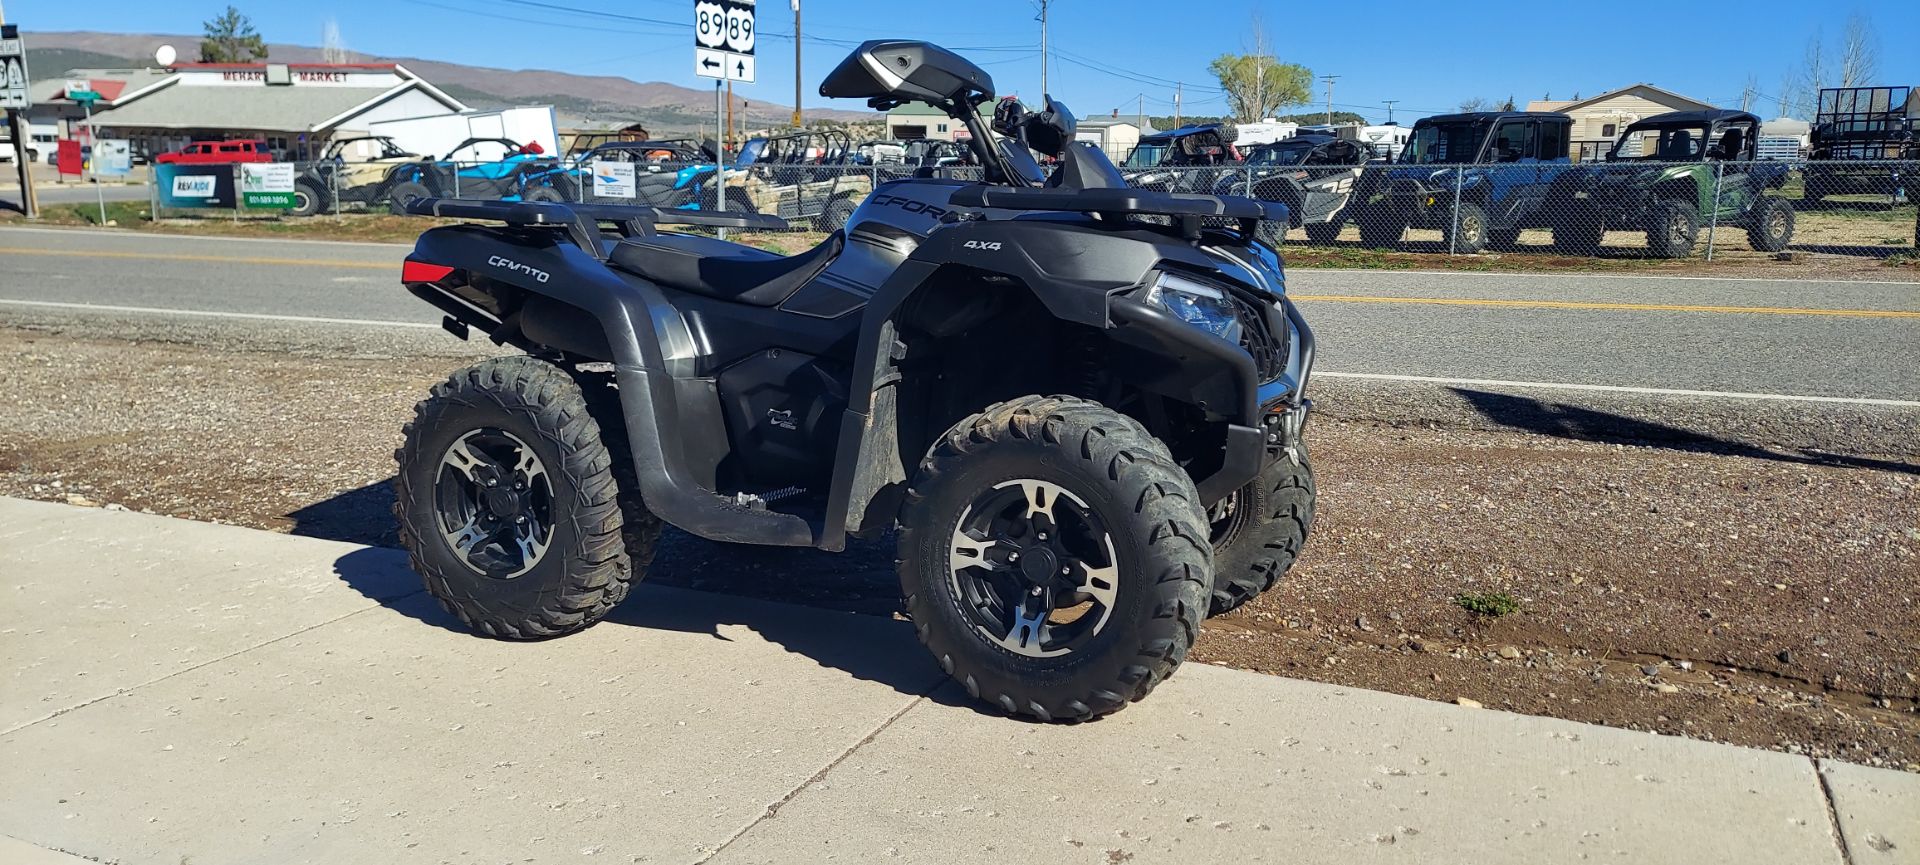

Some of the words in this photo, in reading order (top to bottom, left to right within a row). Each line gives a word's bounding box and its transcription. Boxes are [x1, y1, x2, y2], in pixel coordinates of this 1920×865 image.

[699, 10, 723, 36] 89
[730, 17, 752, 41] 89
[299, 71, 348, 82] MARKET
[487, 254, 550, 284] CFMOTO
